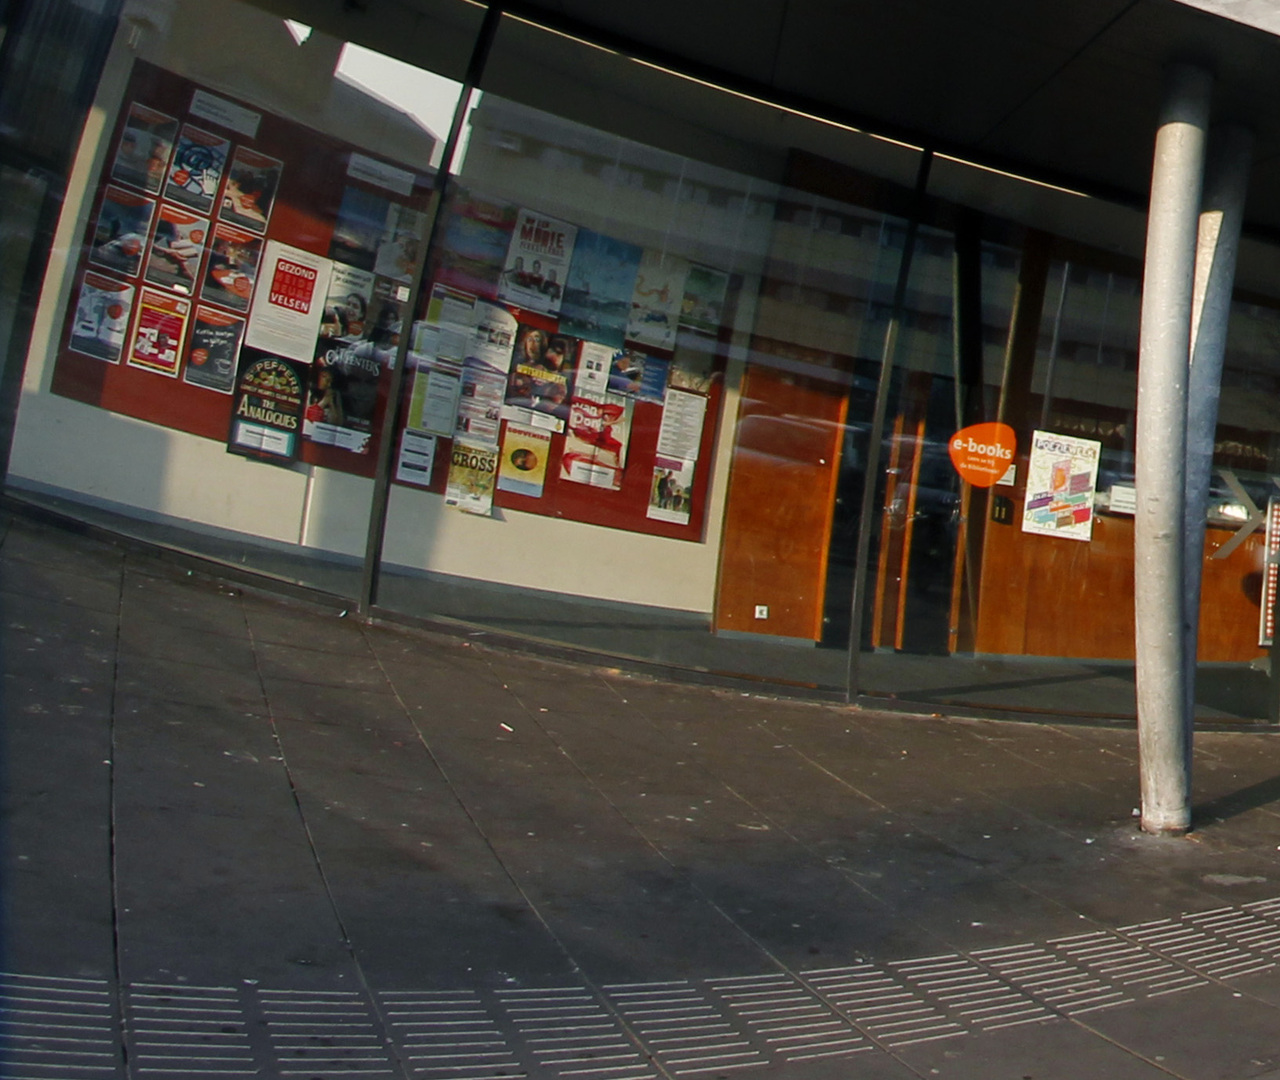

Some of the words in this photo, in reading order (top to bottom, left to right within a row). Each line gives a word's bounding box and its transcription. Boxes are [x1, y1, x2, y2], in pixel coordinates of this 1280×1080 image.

[277, 260, 317, 281] GEZOND
[270, 292, 310, 312] VELSEN
[236, 393, 298, 430] ANALOGUES
[952, 438, 1013, 460] e-books
[451, 450, 497, 475] CROSS
